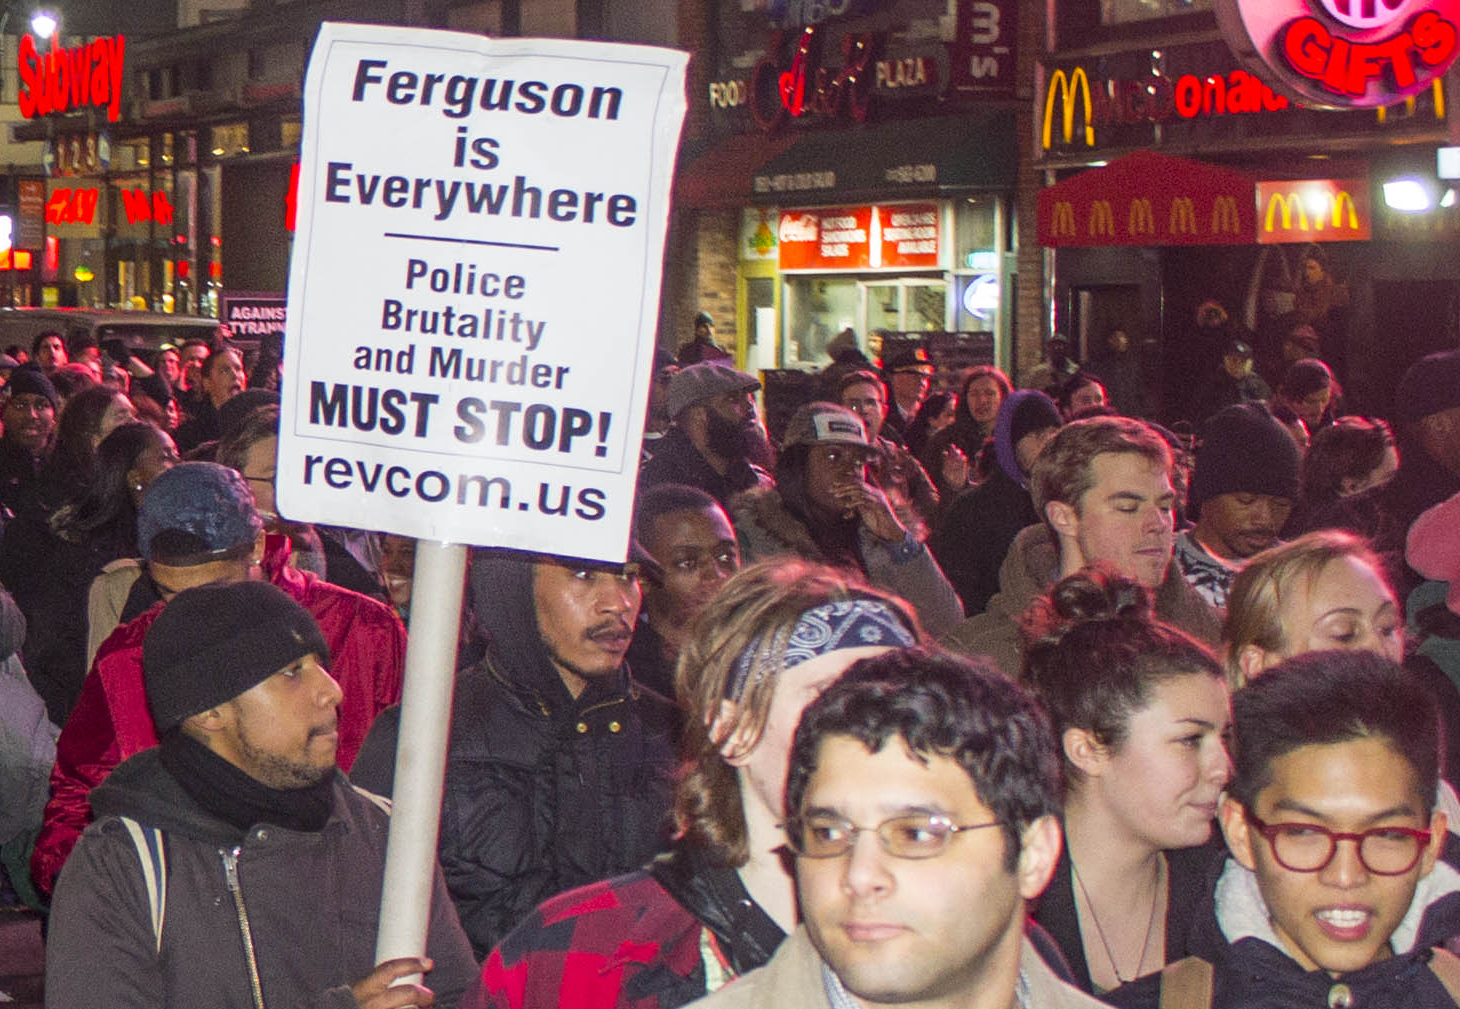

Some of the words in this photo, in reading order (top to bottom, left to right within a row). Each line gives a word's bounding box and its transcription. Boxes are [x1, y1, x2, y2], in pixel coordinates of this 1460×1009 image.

[18, 33, 125, 123] Subway
[876, 56, 928, 89] PLAZA
[1283, 9, 1458, 97] GIFTS
[351, 58, 623, 121] Ferguson
[452, 126, 501, 171] is
[324, 162, 639, 229] Everywhere
[405, 258, 527, 300] Police
[228, 320, 287, 335] TYRANN
[231, 306, 287, 321] AGAINS
[381, 299, 547, 351] Brutality
[353, 342, 415, 377] and
[427, 345, 570, 391] Murder
[309, 381, 439, 442] MUST
[454, 395, 613, 459] STOP!
[303, 453, 608, 522] revcom.us
